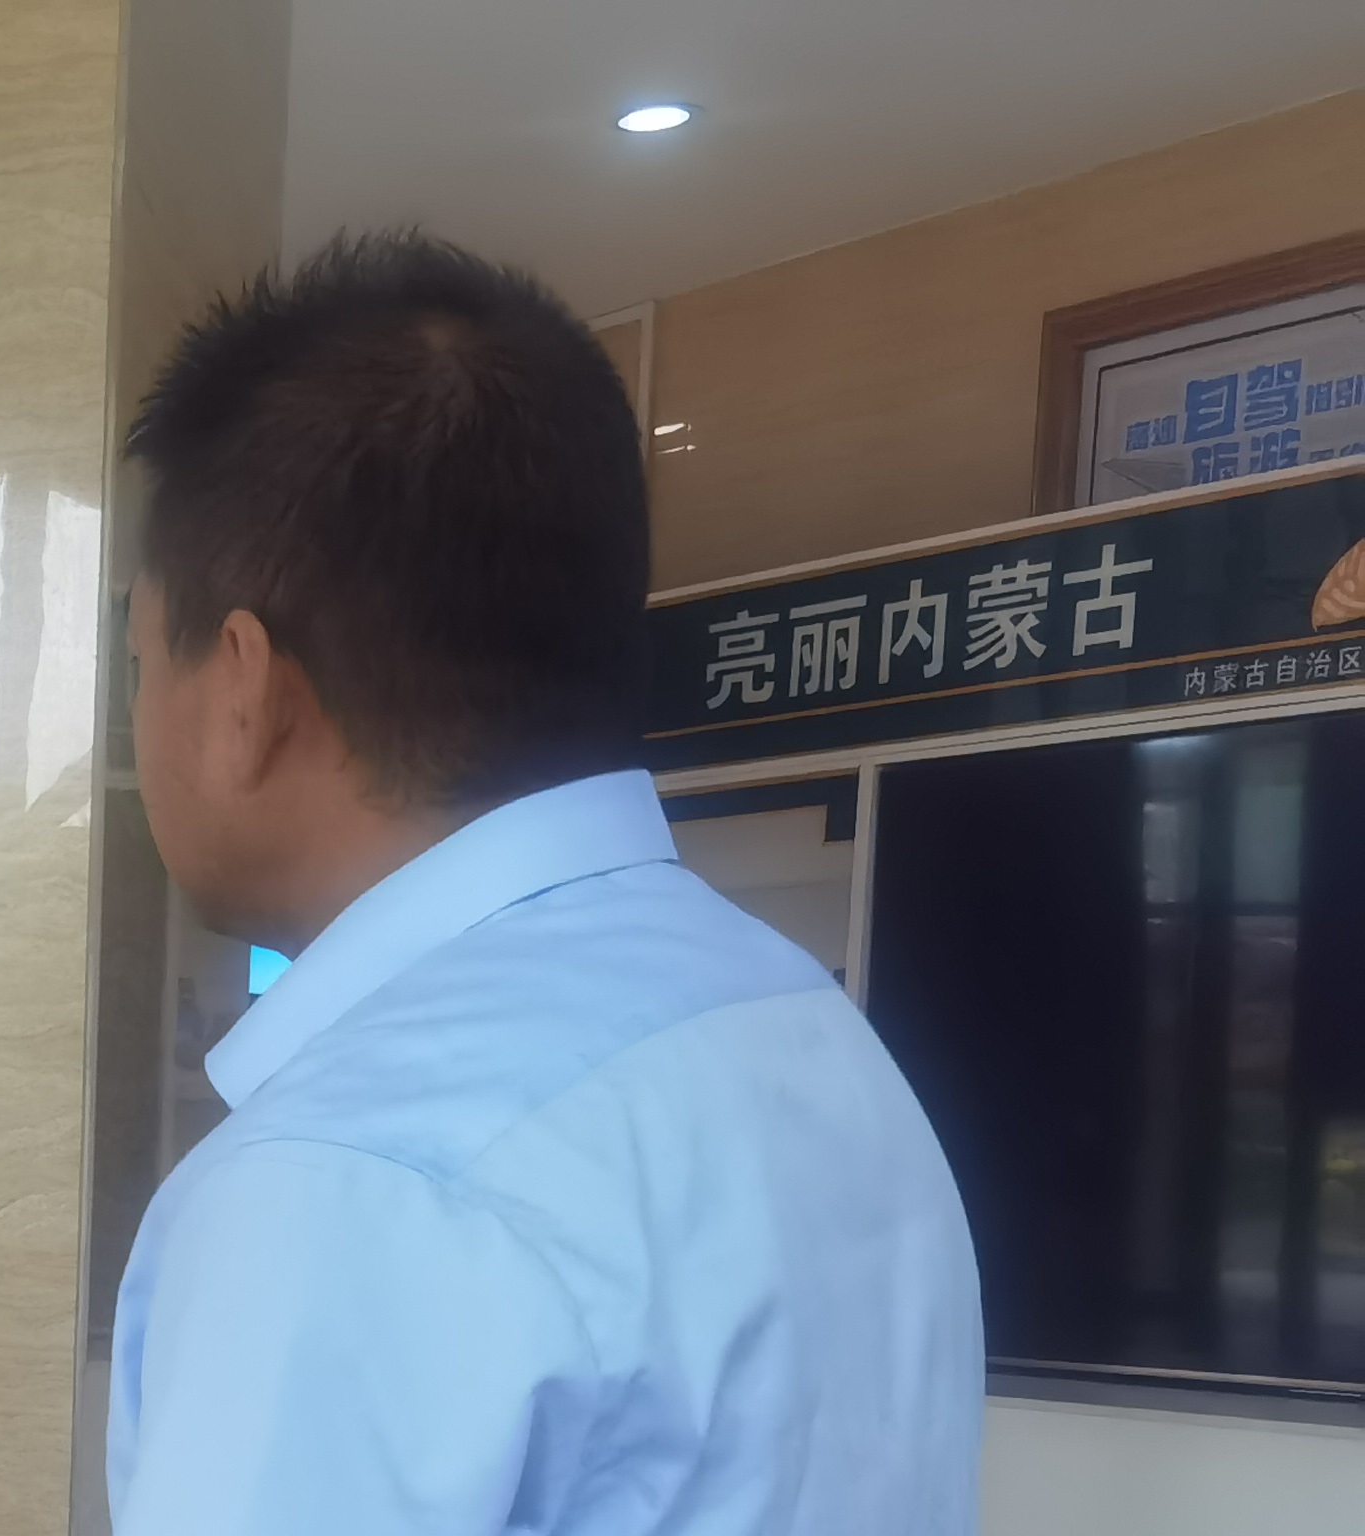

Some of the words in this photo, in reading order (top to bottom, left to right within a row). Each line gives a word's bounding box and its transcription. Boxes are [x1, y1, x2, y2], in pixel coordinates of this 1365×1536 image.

[704, 543, 1154, 710] 亮丽内蒙古
[1184, 646, 1362, 697] 内蒙古自治区
